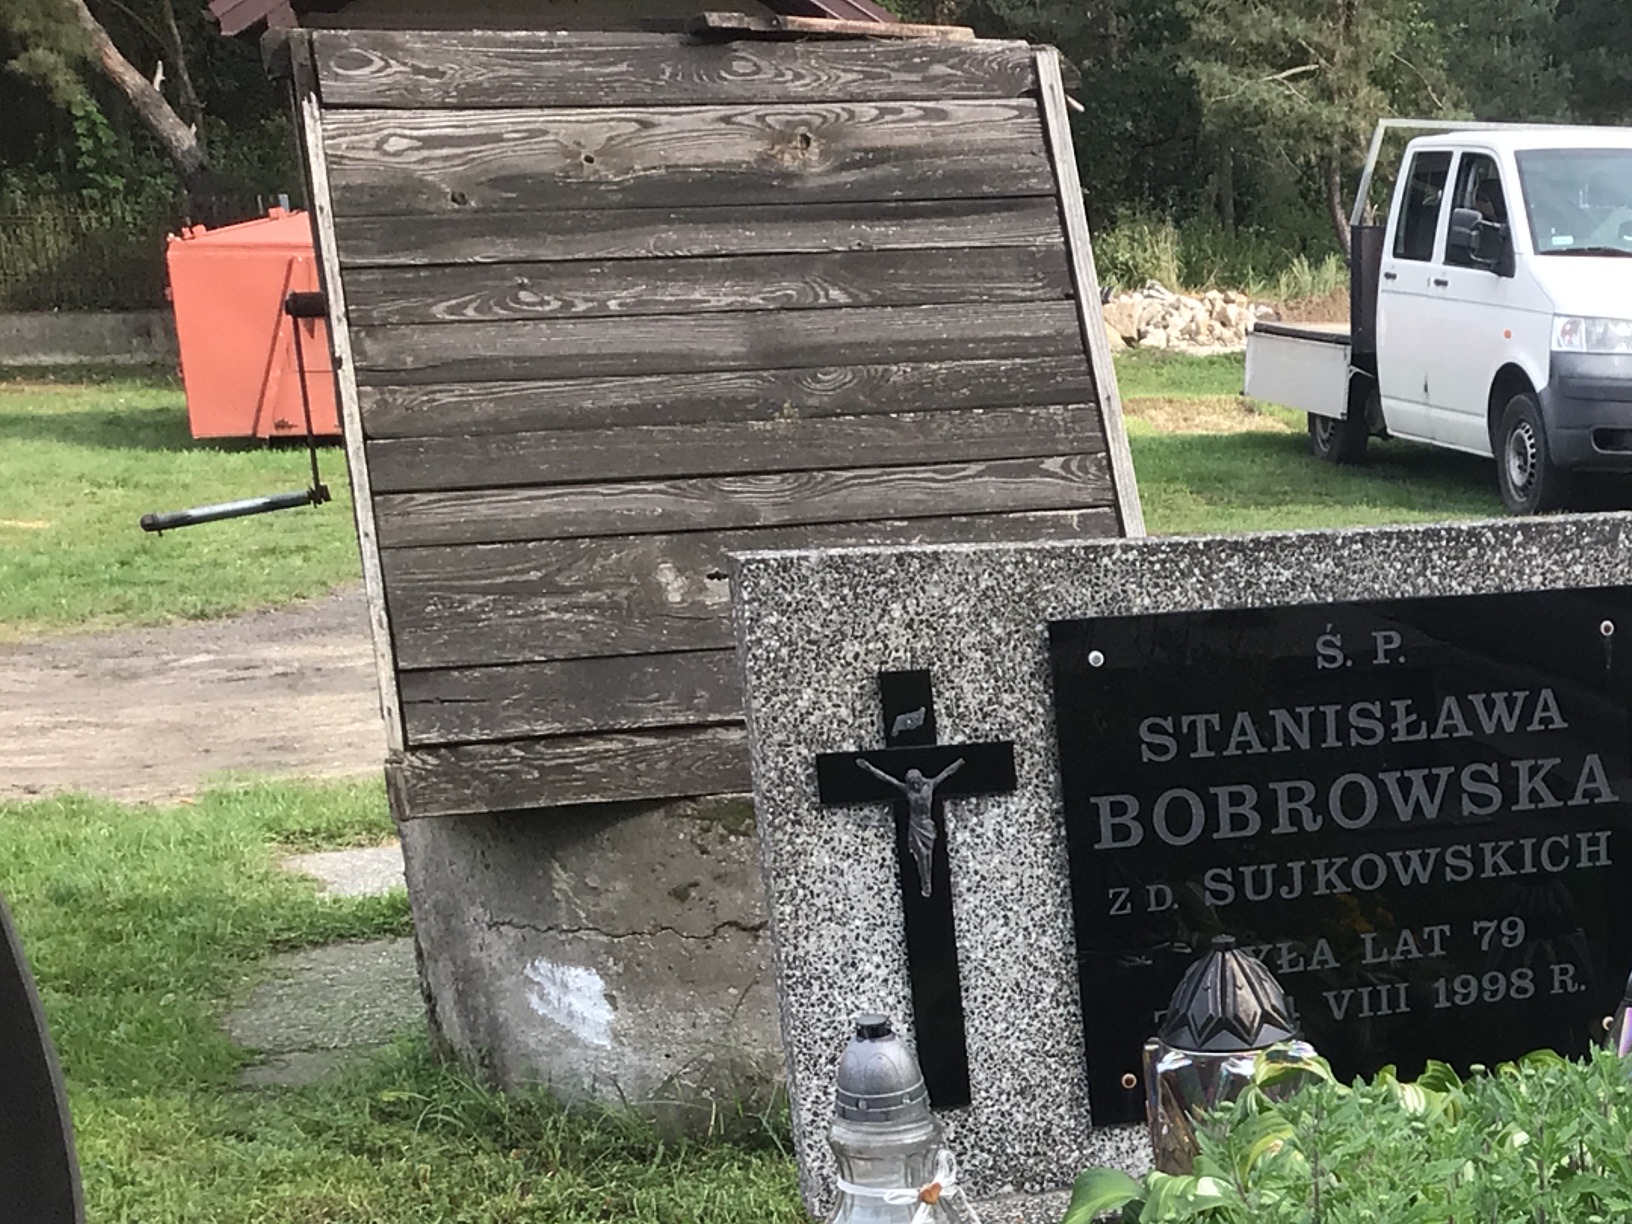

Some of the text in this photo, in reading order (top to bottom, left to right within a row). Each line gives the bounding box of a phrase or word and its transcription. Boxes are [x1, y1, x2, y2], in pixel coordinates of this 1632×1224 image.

[1139, 687, 1568, 763] STANISŁAWA
[1090, 753, 1619, 850] BOBROWSKA
[1108, 887, 1132, 915] Z
[1203, 830, 1612, 906] SUJKOWSKICH
[1241, 916, 1526, 974] YŁA LAT 79
[1322, 982, 1411, 1021] VIII
[1433, 968, 1535, 1009] 1998
